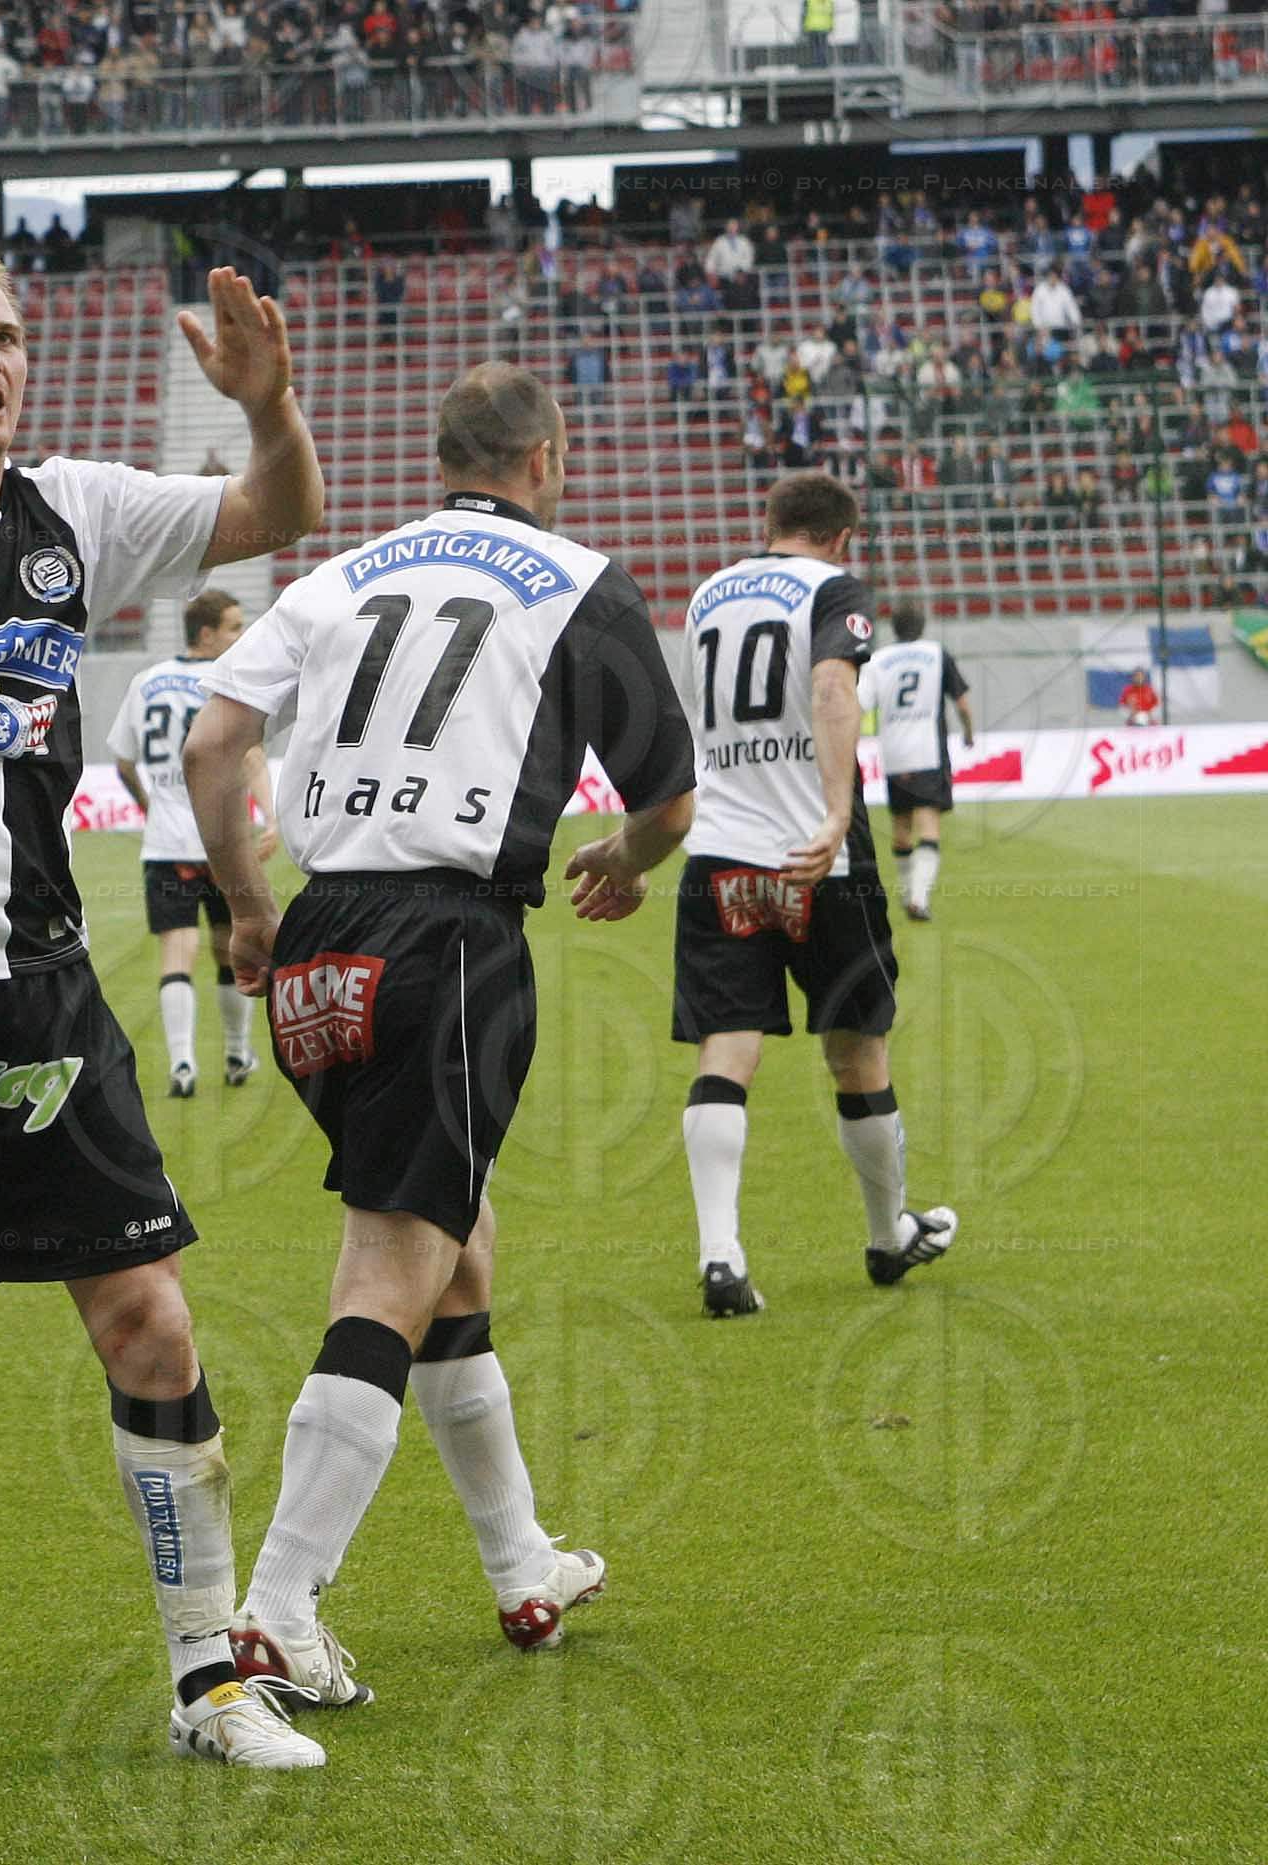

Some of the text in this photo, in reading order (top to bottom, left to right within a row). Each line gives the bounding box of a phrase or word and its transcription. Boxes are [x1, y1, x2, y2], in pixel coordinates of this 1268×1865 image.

[352, 534, 557, 596] PUNTIGAMER
[692, 576, 805, 622] PUNTIGAMER
[335, 594, 498, 751] 11
[699, 619, 791, 733] 10
[898, 671, 920, 708] 2
[143, 1215, 172, 1234] JAKO
